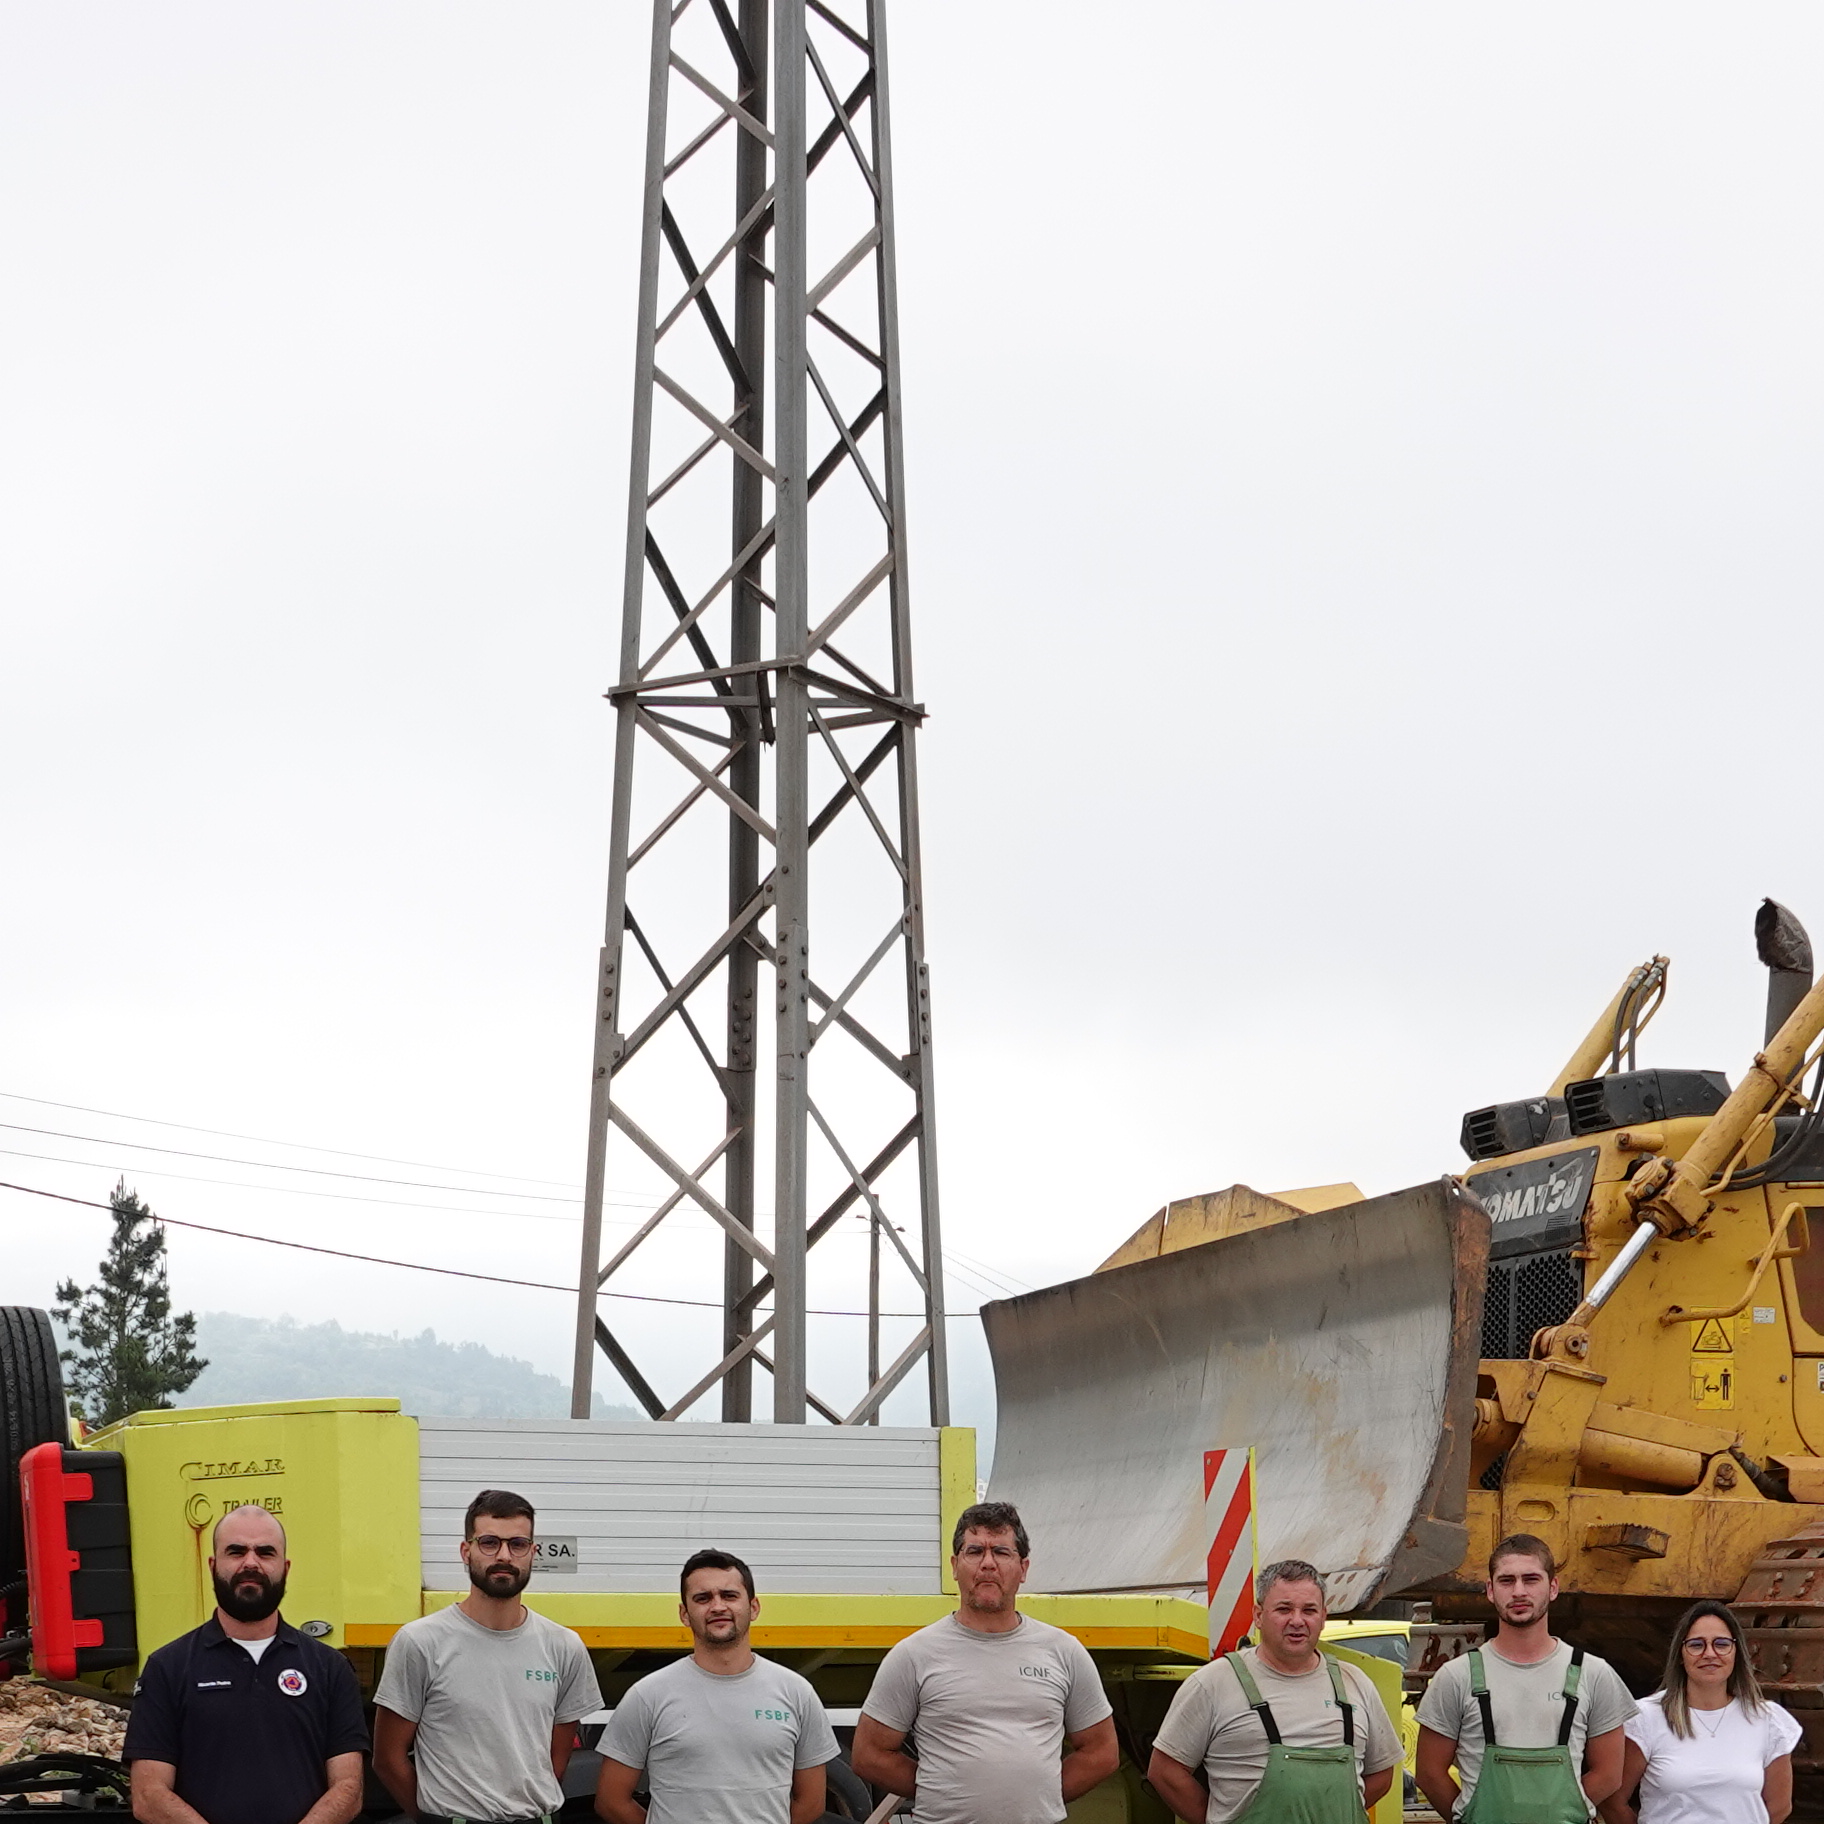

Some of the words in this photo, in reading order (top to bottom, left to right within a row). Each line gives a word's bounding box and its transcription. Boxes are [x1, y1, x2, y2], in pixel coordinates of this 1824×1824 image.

[179, 1458, 285, 1482] CIMAR
[548, 1543, 575, 1557] SA.
[526, 1669, 558, 1683] FSBF
[1018, 1666, 1051, 1677] ICNF
[754, 1709, 791, 1722] FSBF
